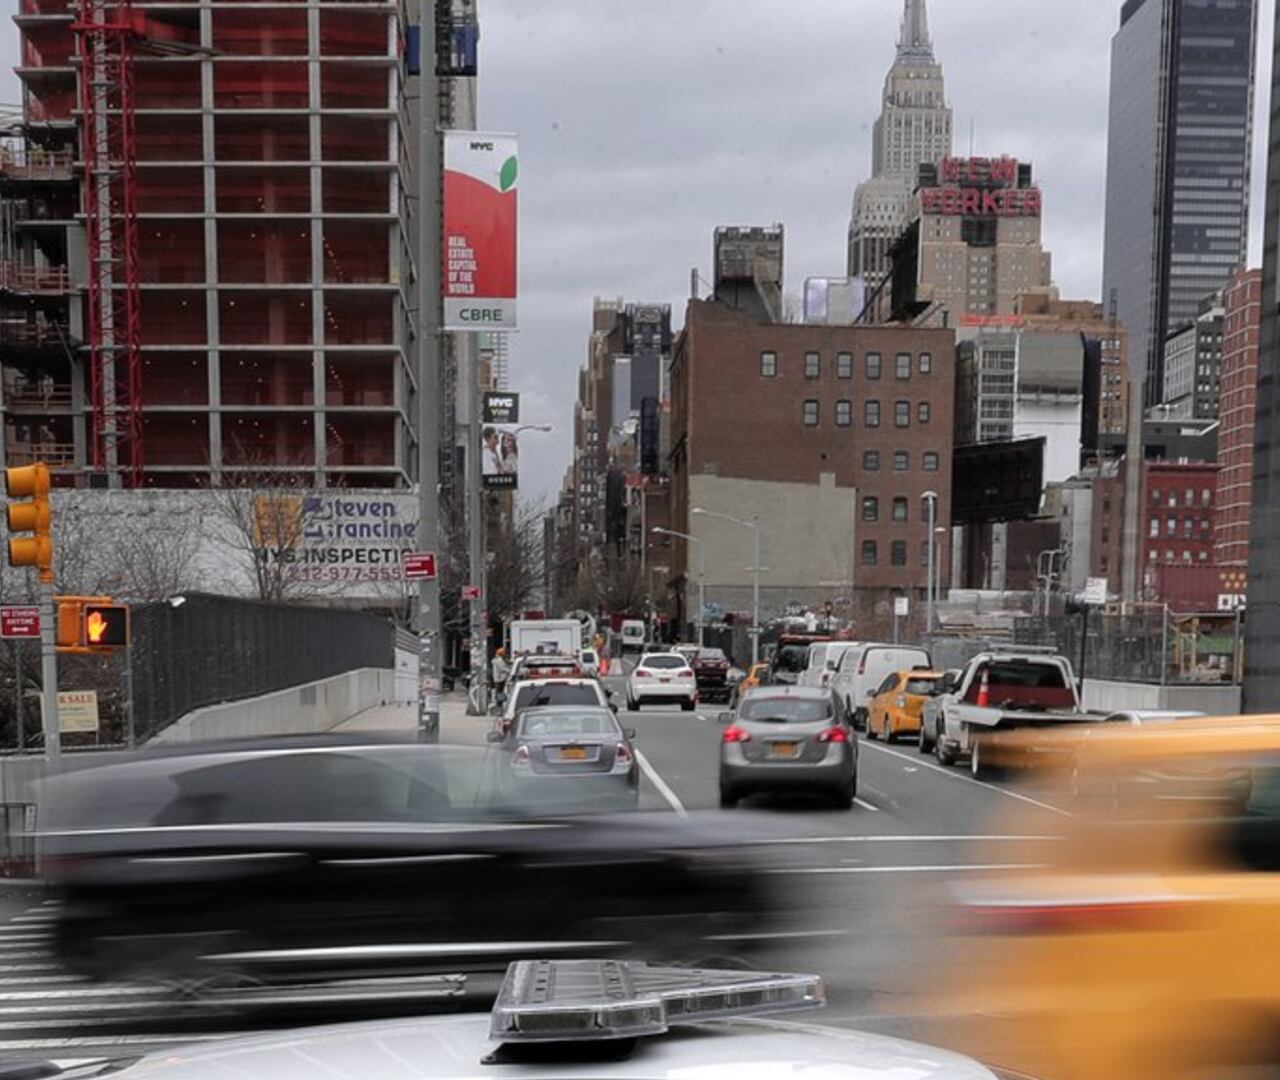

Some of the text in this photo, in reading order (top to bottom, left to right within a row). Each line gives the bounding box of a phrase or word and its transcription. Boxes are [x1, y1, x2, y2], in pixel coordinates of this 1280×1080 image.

[470, 142, 494, 151] NYC
[942, 155, 1018, 182] NEW
[919, 187, 1042, 217] YORKER
[459, 308, 503, 321] CBRE
[488, 397, 513, 407] NYC
